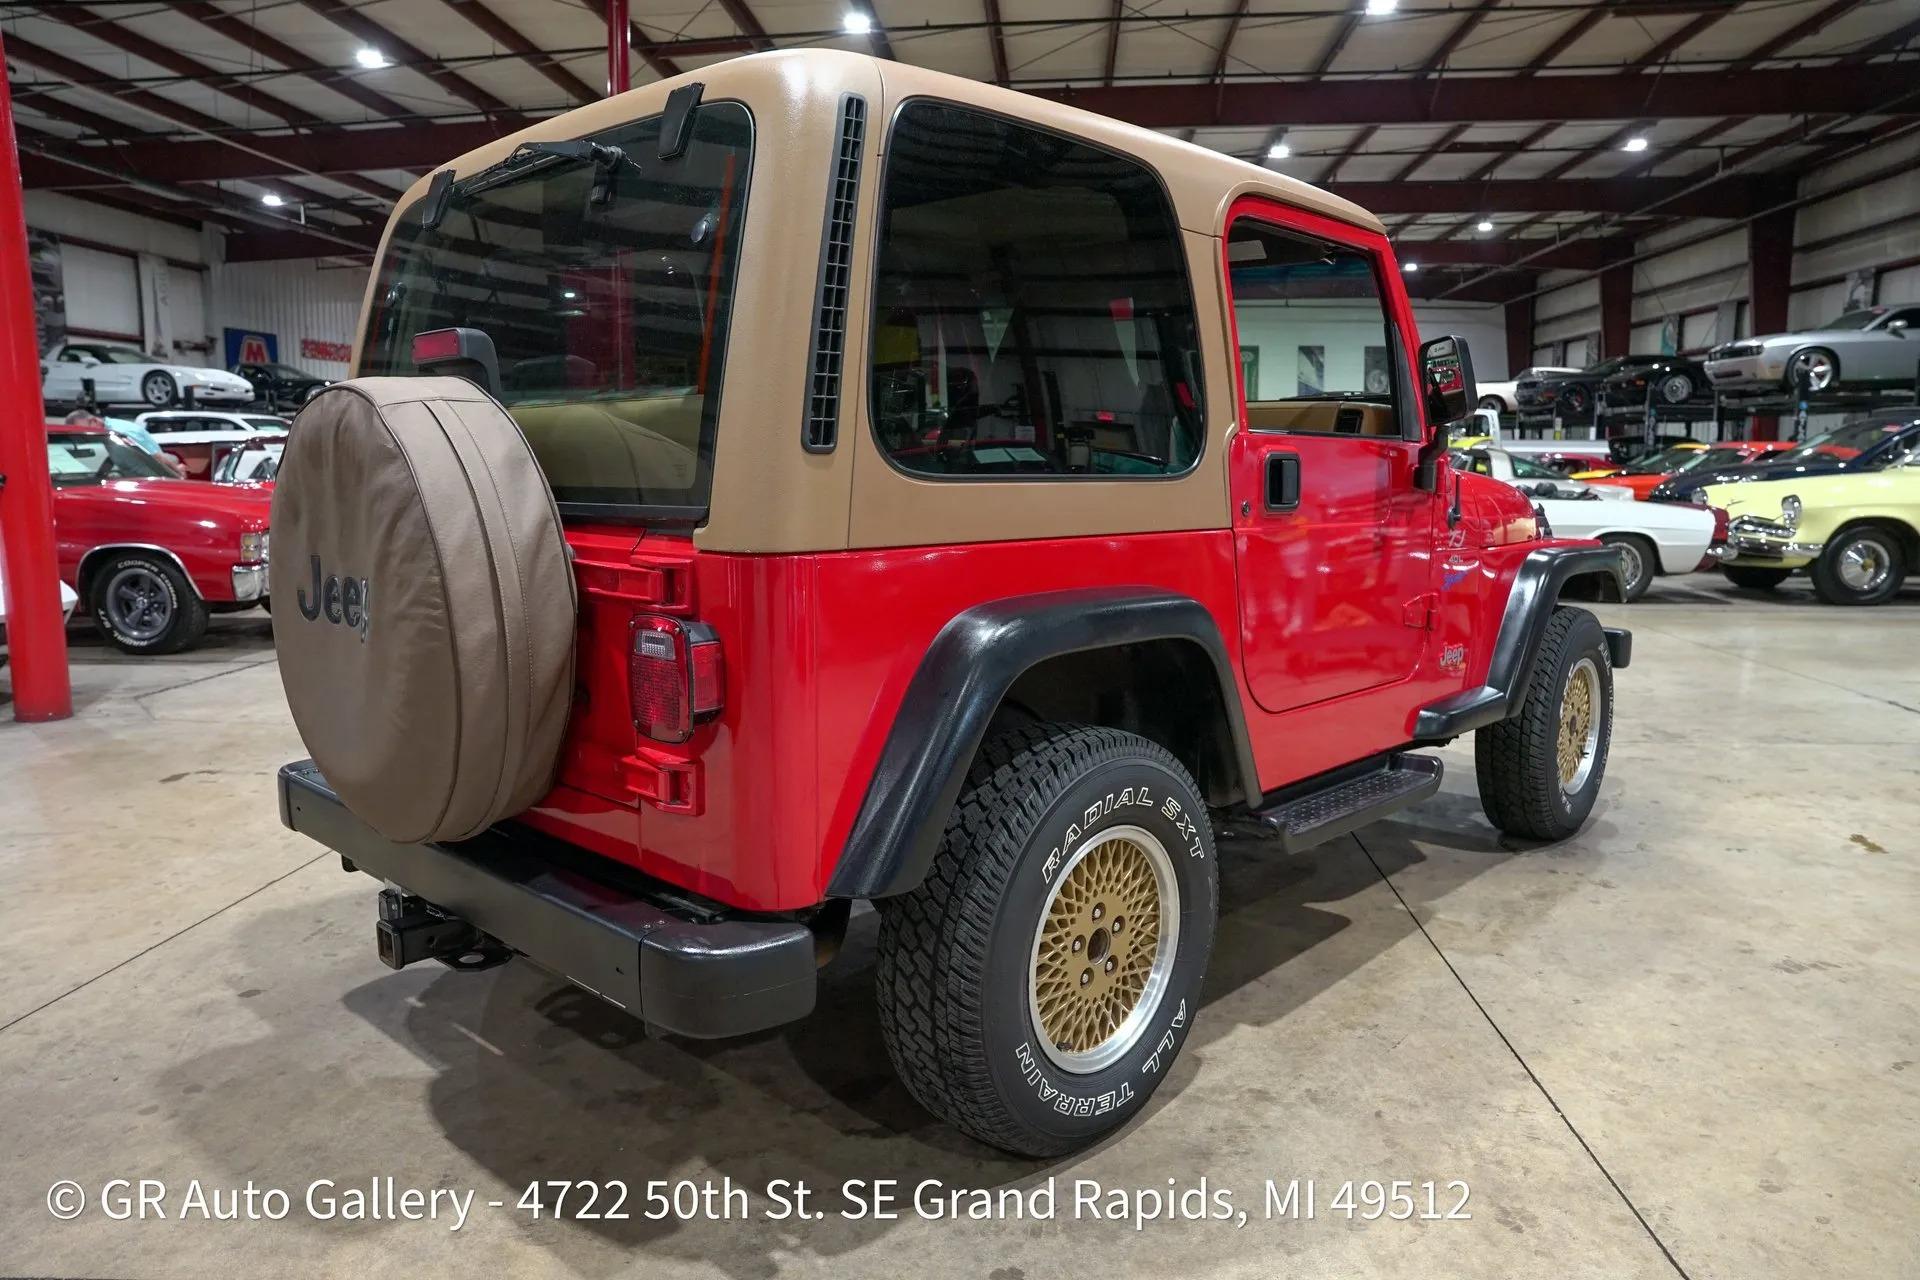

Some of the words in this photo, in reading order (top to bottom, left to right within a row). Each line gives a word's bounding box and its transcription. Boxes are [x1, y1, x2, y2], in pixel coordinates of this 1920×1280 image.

[117, 559, 159, 573] COOPER
[1439, 645, 1465, 667] Jeep
[1042, 787, 1154, 884] RADIAL
[1161, 796, 1205, 859] SXT
[1142, 998, 1187, 1075] ALL
[1015, 1042, 1136, 1118] TERRAIN
